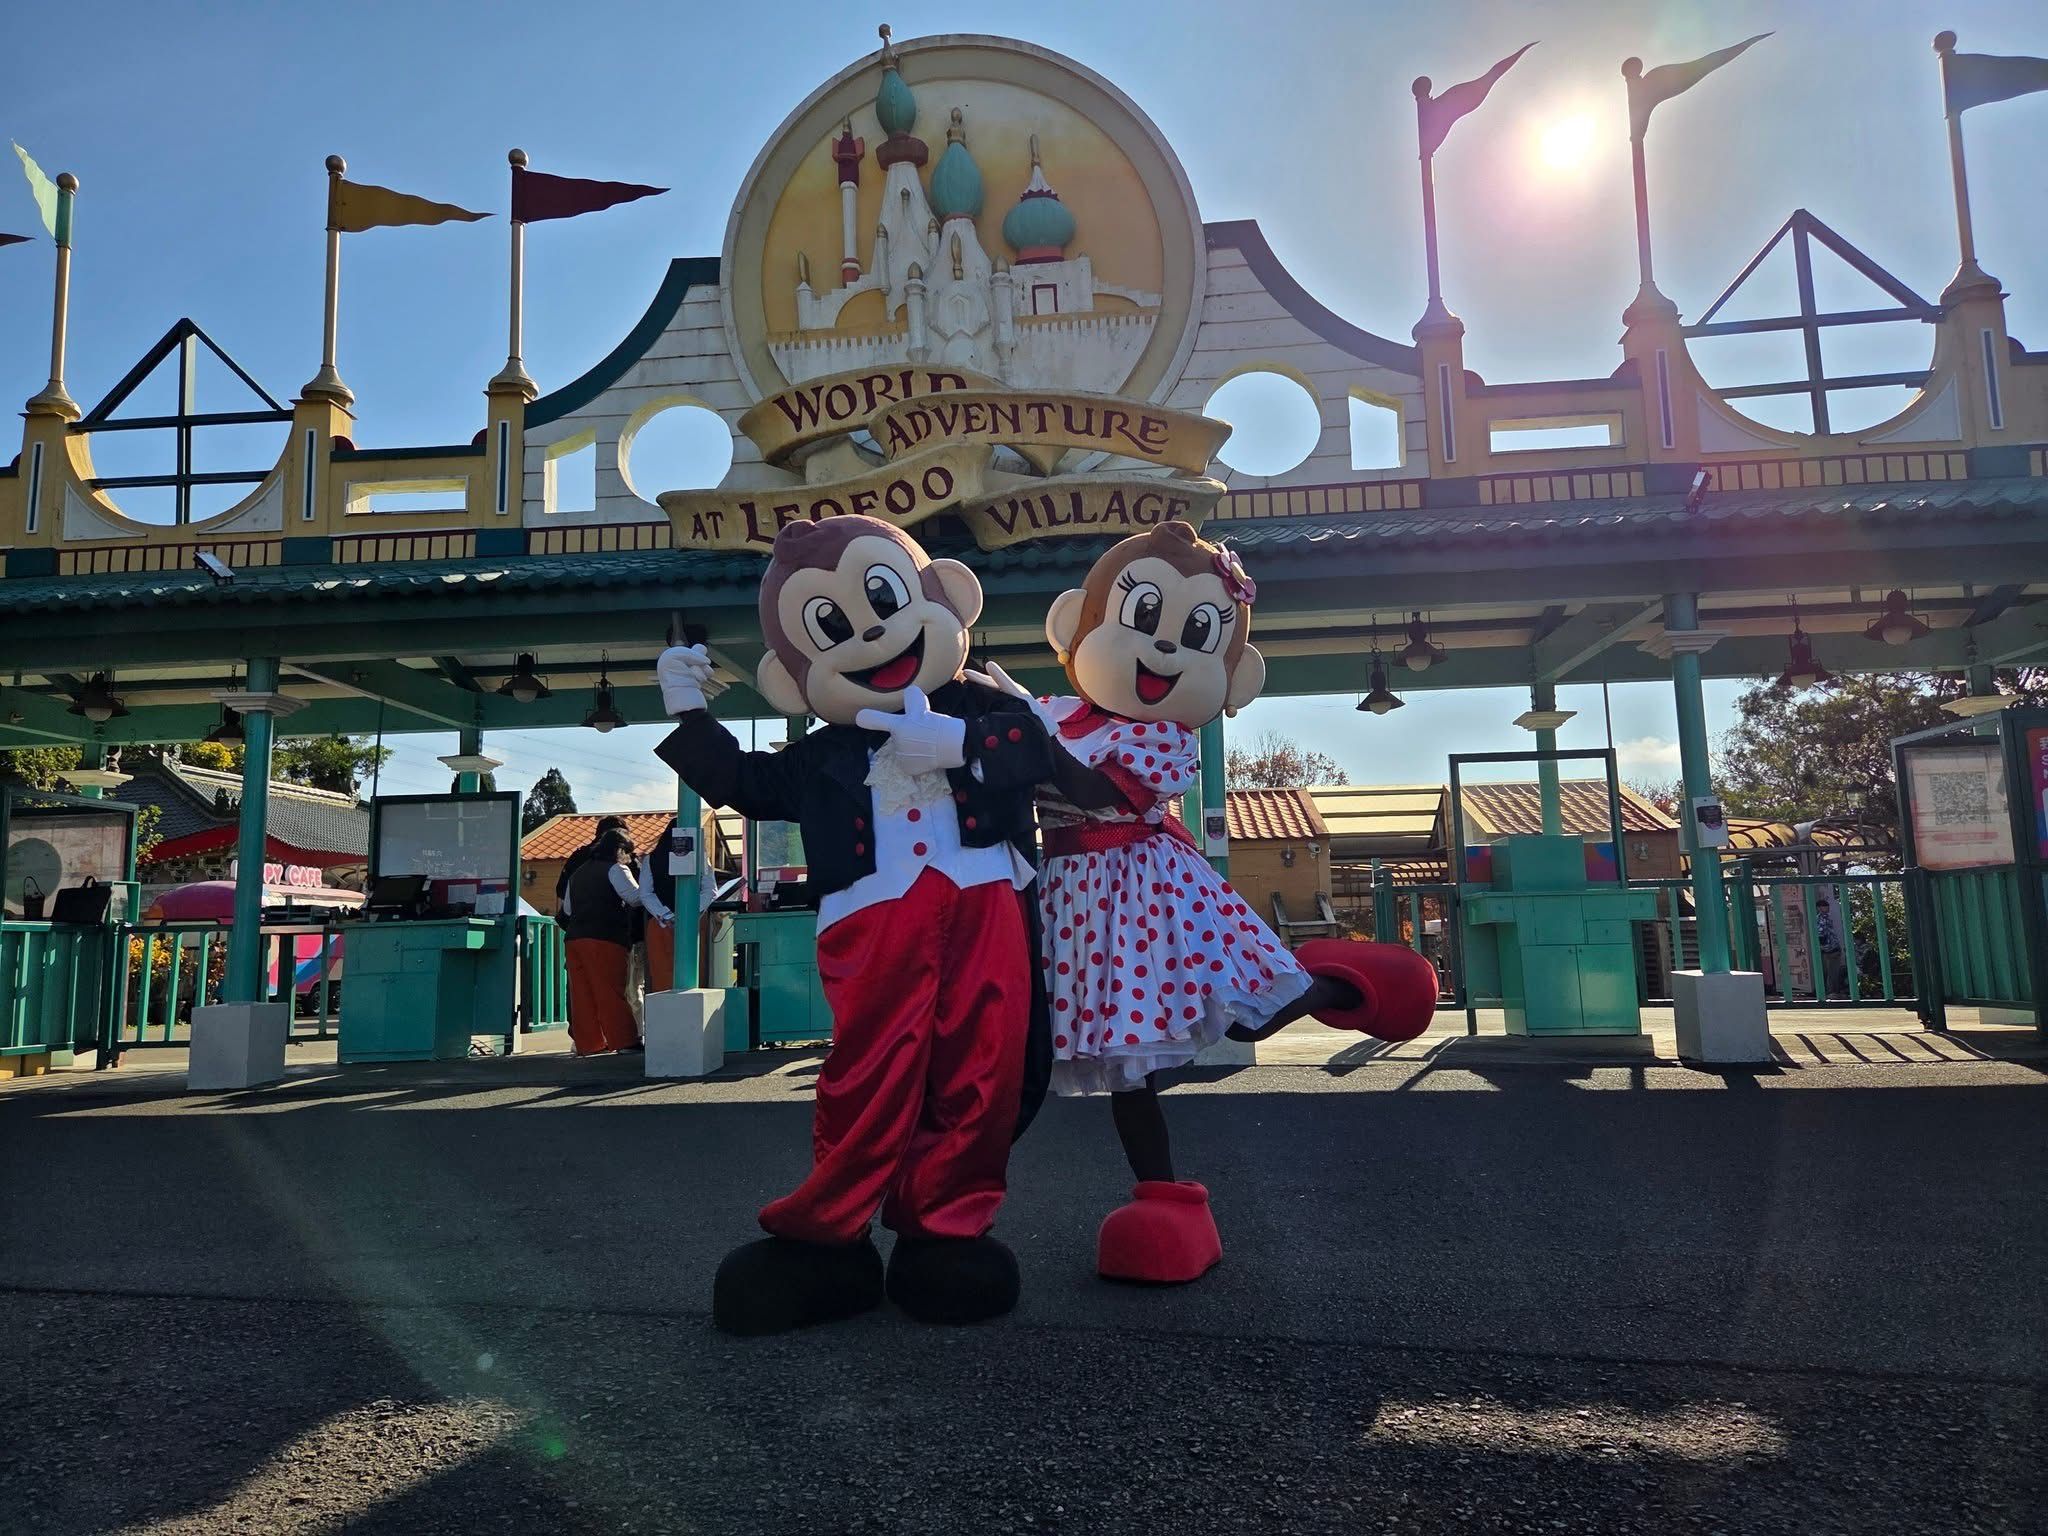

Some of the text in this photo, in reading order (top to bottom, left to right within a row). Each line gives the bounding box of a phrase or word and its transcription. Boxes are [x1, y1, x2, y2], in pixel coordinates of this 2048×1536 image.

[885, 402, 1170, 460] ADVENTURE
[691, 512, 724, 541] AT
[985, 490, 1190, 535] VILLAGE
[286, 864, 323, 888] CAFE
